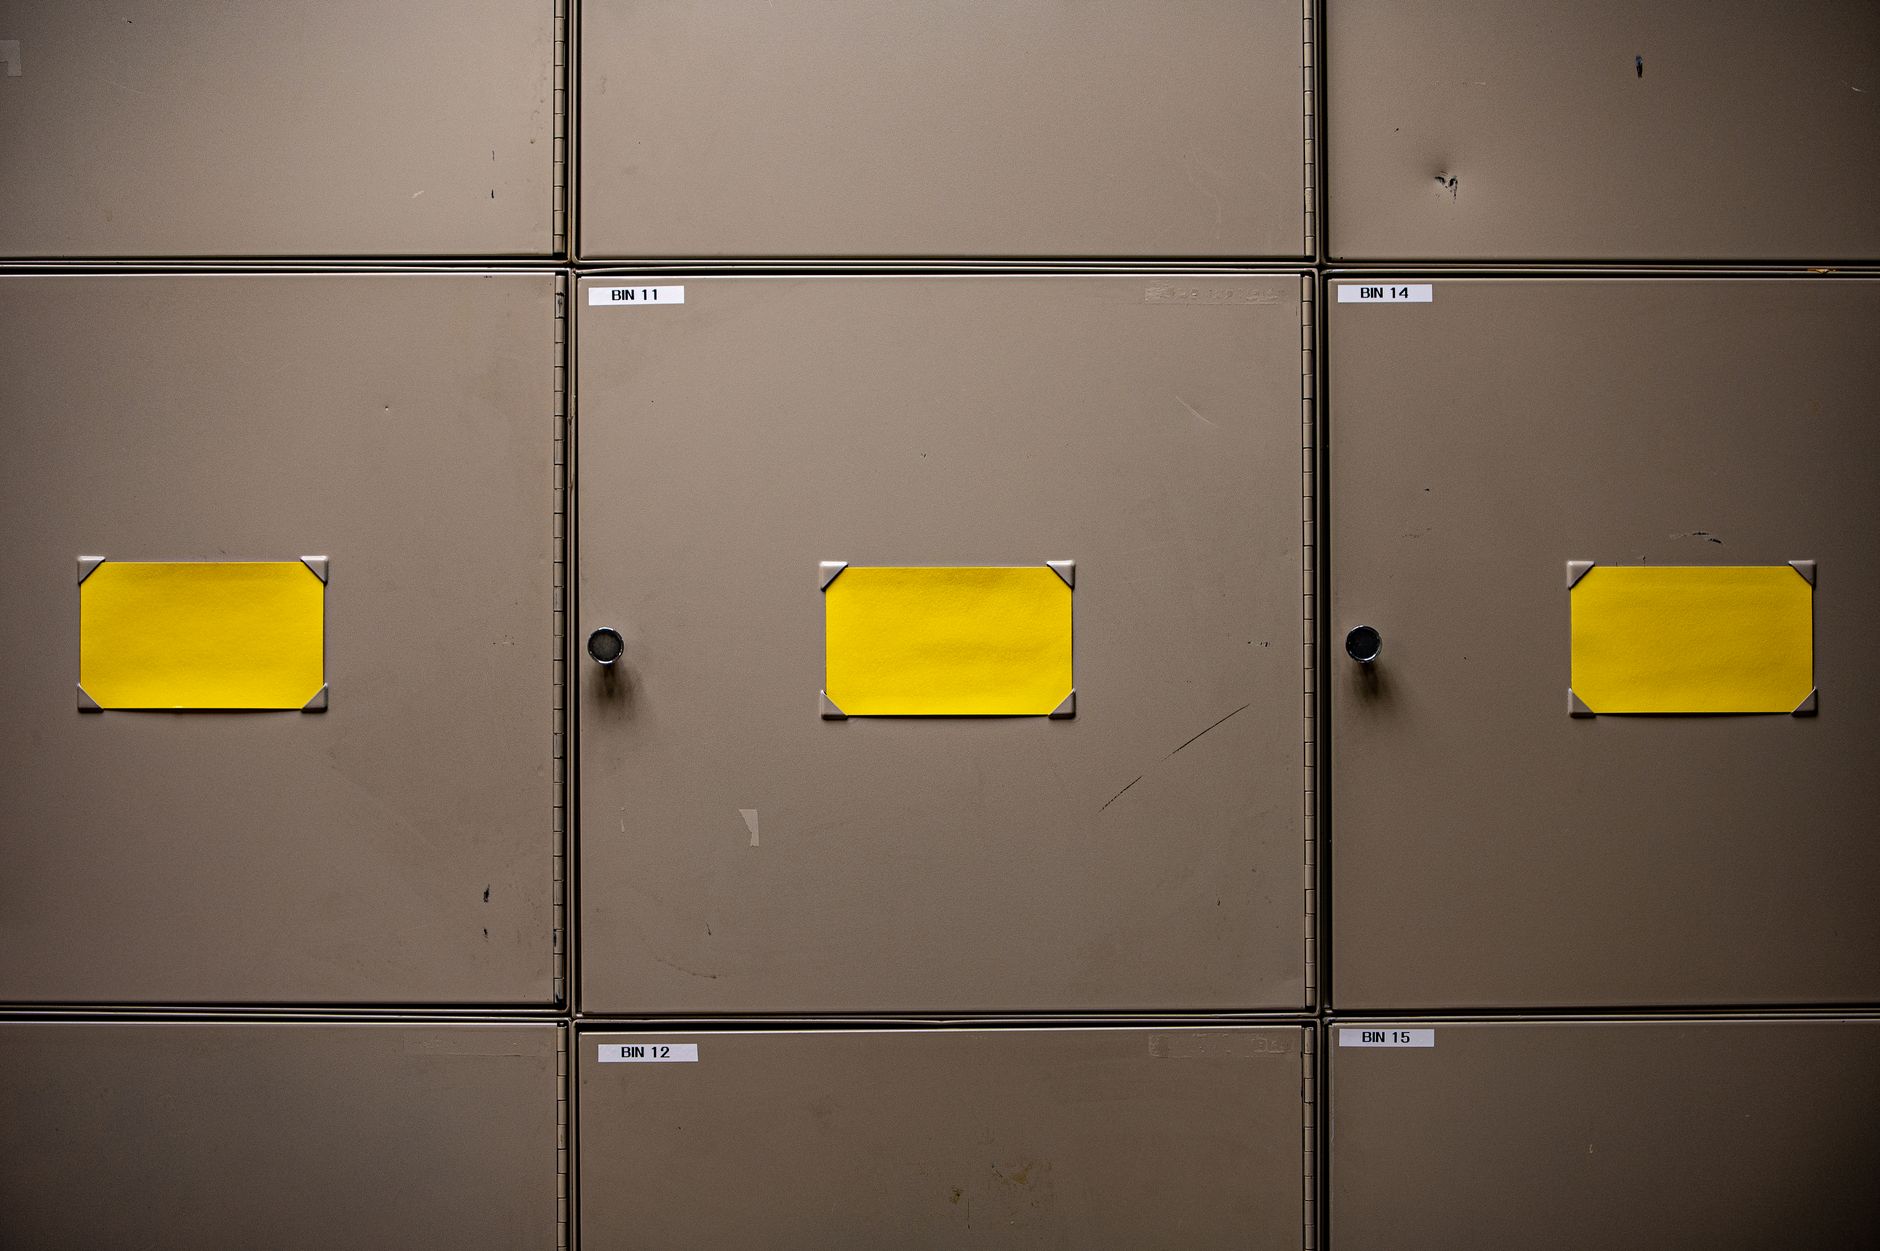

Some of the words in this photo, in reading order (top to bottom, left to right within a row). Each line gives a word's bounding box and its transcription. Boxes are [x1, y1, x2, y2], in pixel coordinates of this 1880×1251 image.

[611, 289, 634, 300] BIN
[642, 289, 657, 300] 11
[1360, 287, 1383, 298] BIN
[1390, 287, 1408, 298] 14
[1362, 1031, 1385, 1043] BIN
[1392, 1031, 1410, 1043] 15
[621, 1047, 644, 1058] BIN
[651, 1047, 670, 1058] 12
